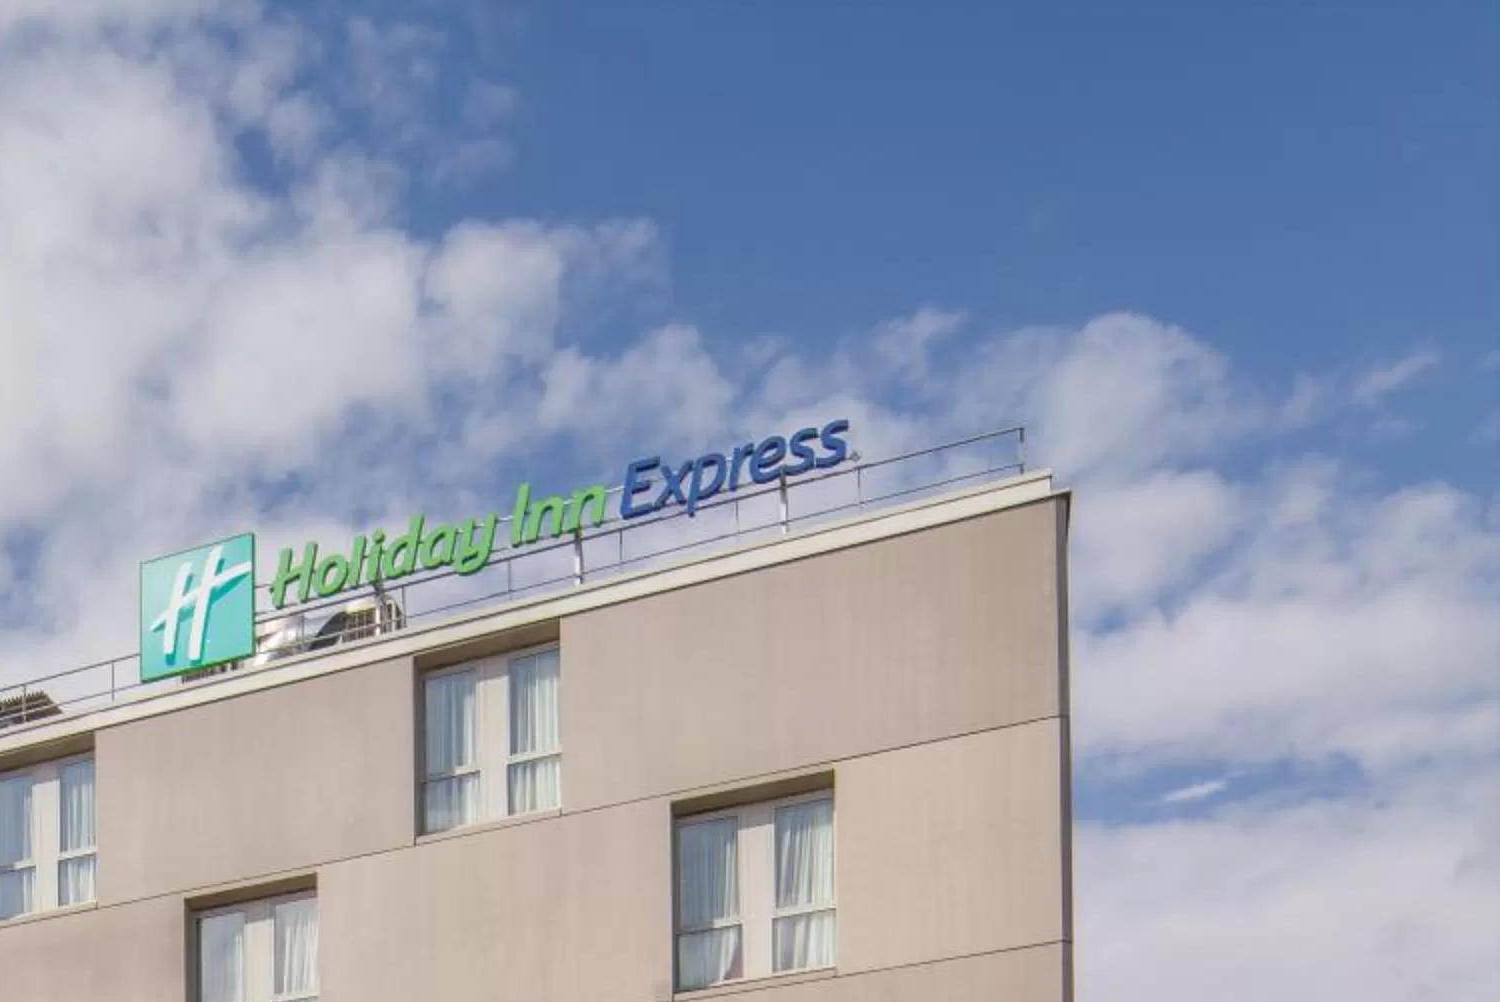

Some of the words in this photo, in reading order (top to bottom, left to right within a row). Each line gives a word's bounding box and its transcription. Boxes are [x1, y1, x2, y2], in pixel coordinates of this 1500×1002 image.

[269, 511, 498, 609] Holiday
[510, 482, 606, 547] Inn
[620, 418, 849, 516] Express
